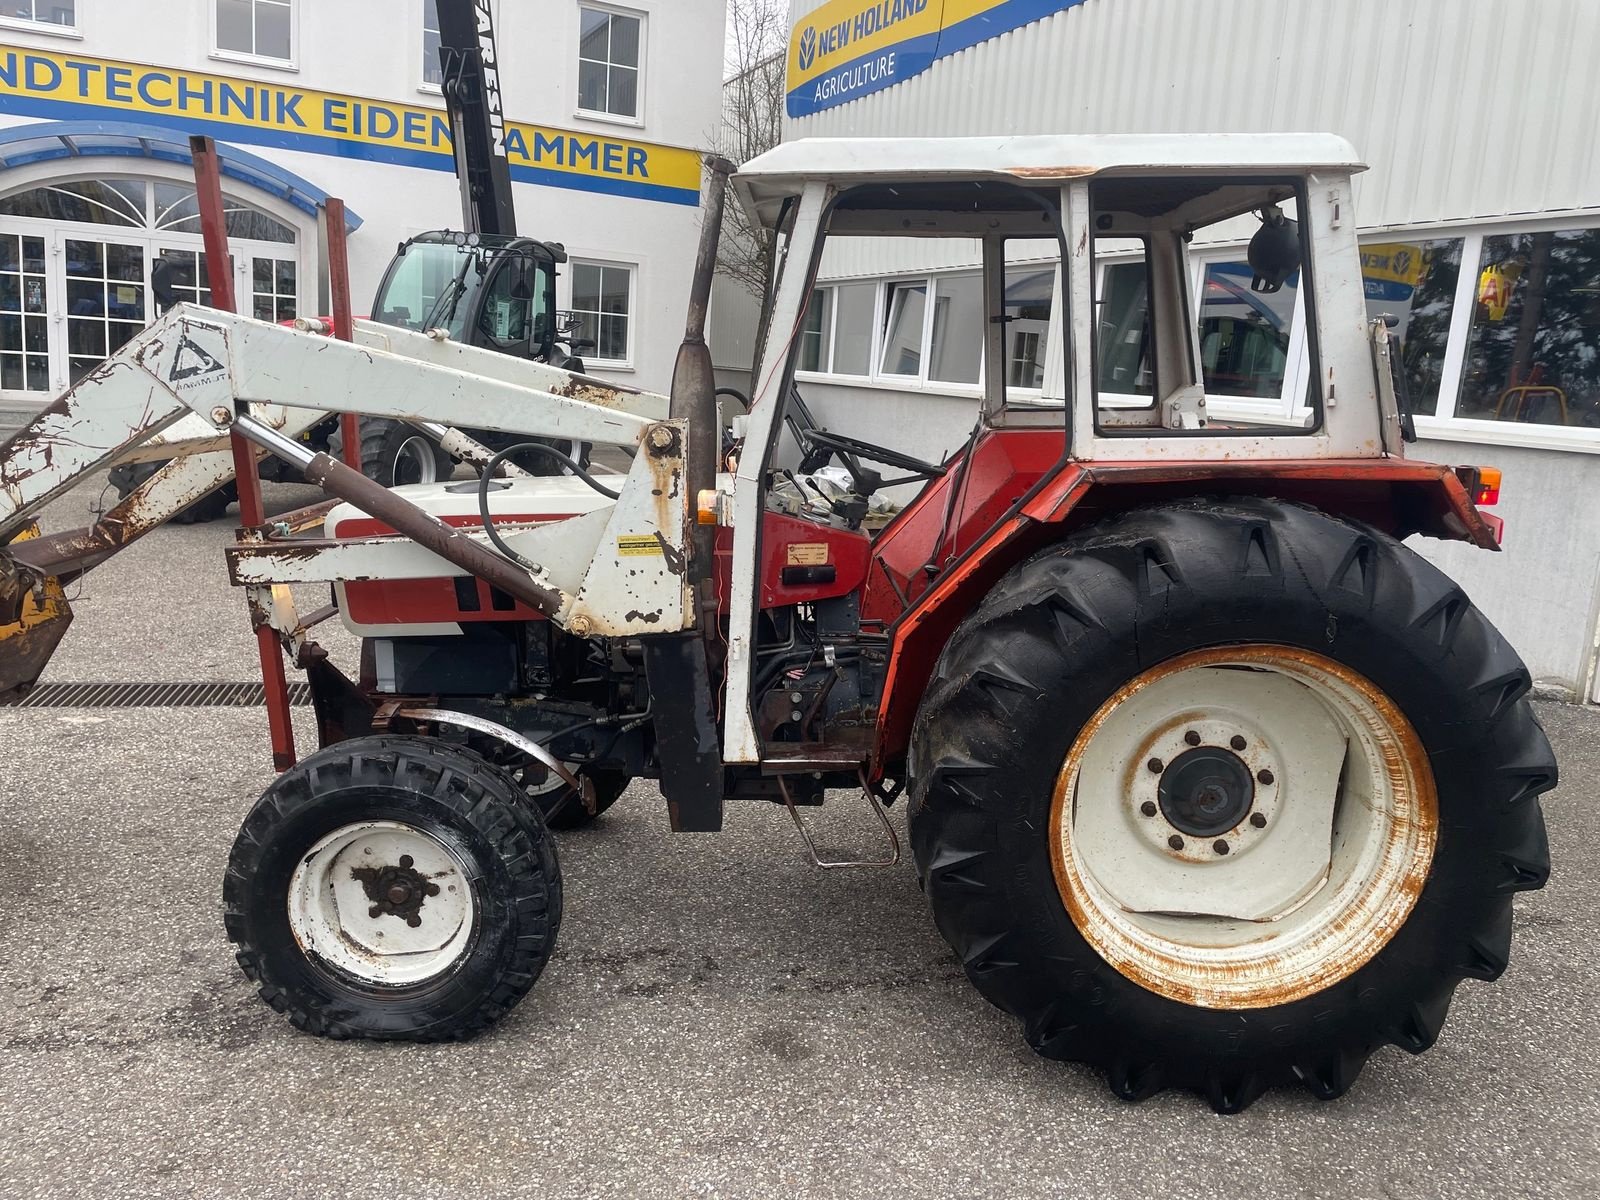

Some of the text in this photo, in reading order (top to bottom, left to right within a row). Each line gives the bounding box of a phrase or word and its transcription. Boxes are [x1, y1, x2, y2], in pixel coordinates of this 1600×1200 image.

[818, 0, 928, 58] NEW HOLLAND
[814, 52, 896, 103] AGRICULTURE
[322, 98, 650, 178] EIDENAMMER
